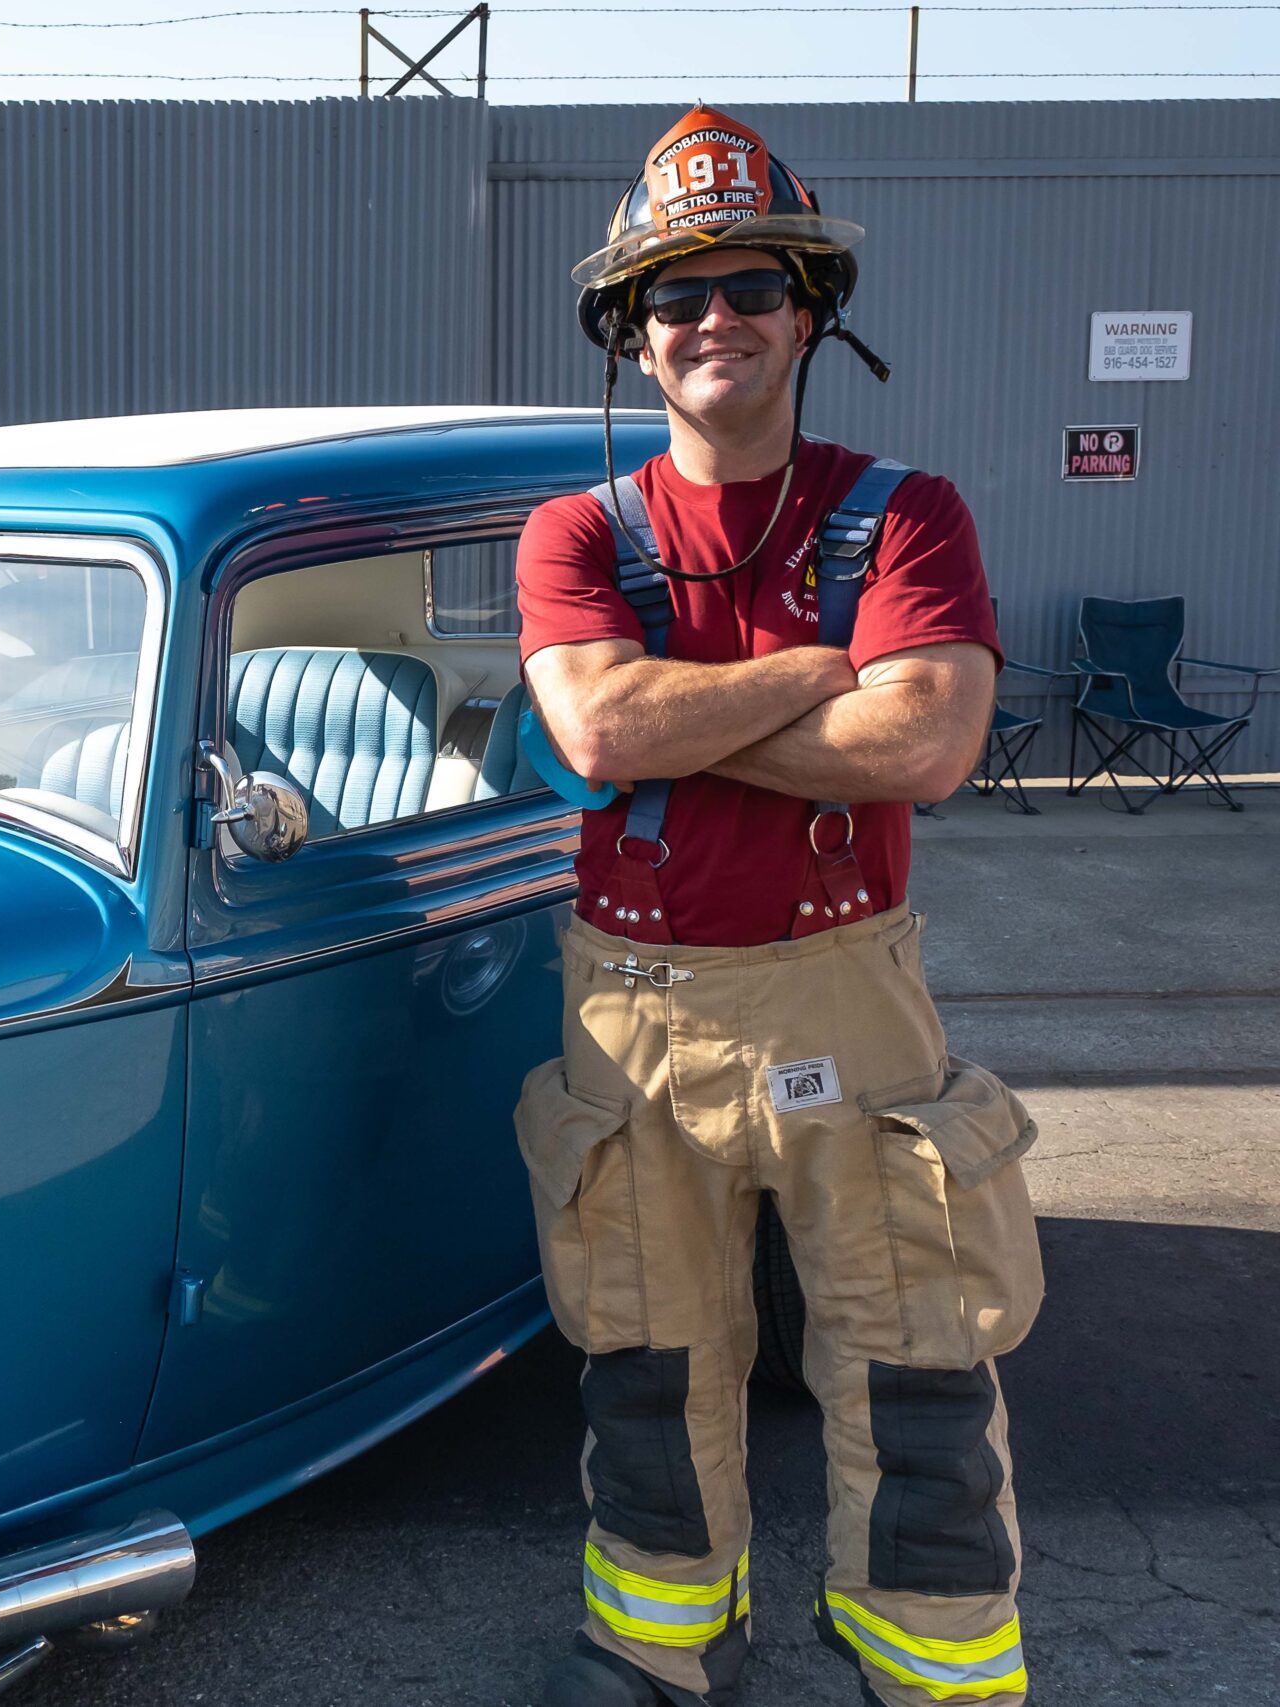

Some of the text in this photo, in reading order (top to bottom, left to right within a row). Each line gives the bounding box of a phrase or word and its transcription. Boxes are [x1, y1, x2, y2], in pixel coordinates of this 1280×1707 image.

[658, 130, 755, 167] PROBATIONARY
[659, 152, 757, 203] 19-1
[666, 191, 755, 216] METRO FIRE
[669, 209, 757, 229] SACRAMENTO
[1105, 323, 1178, 336] WARNING
[1140, 346, 1153, 355] DOG
[1154, 345, 1178, 355] SERVICE
[1104, 356, 1177, 369] 916-454-1527
[1079, 433, 1099, 452] NO
[1071, 454, 1131, 473] PARKING
[781, 590, 804, 619] BURN
[778, 1065, 807, 1075] MORNING
